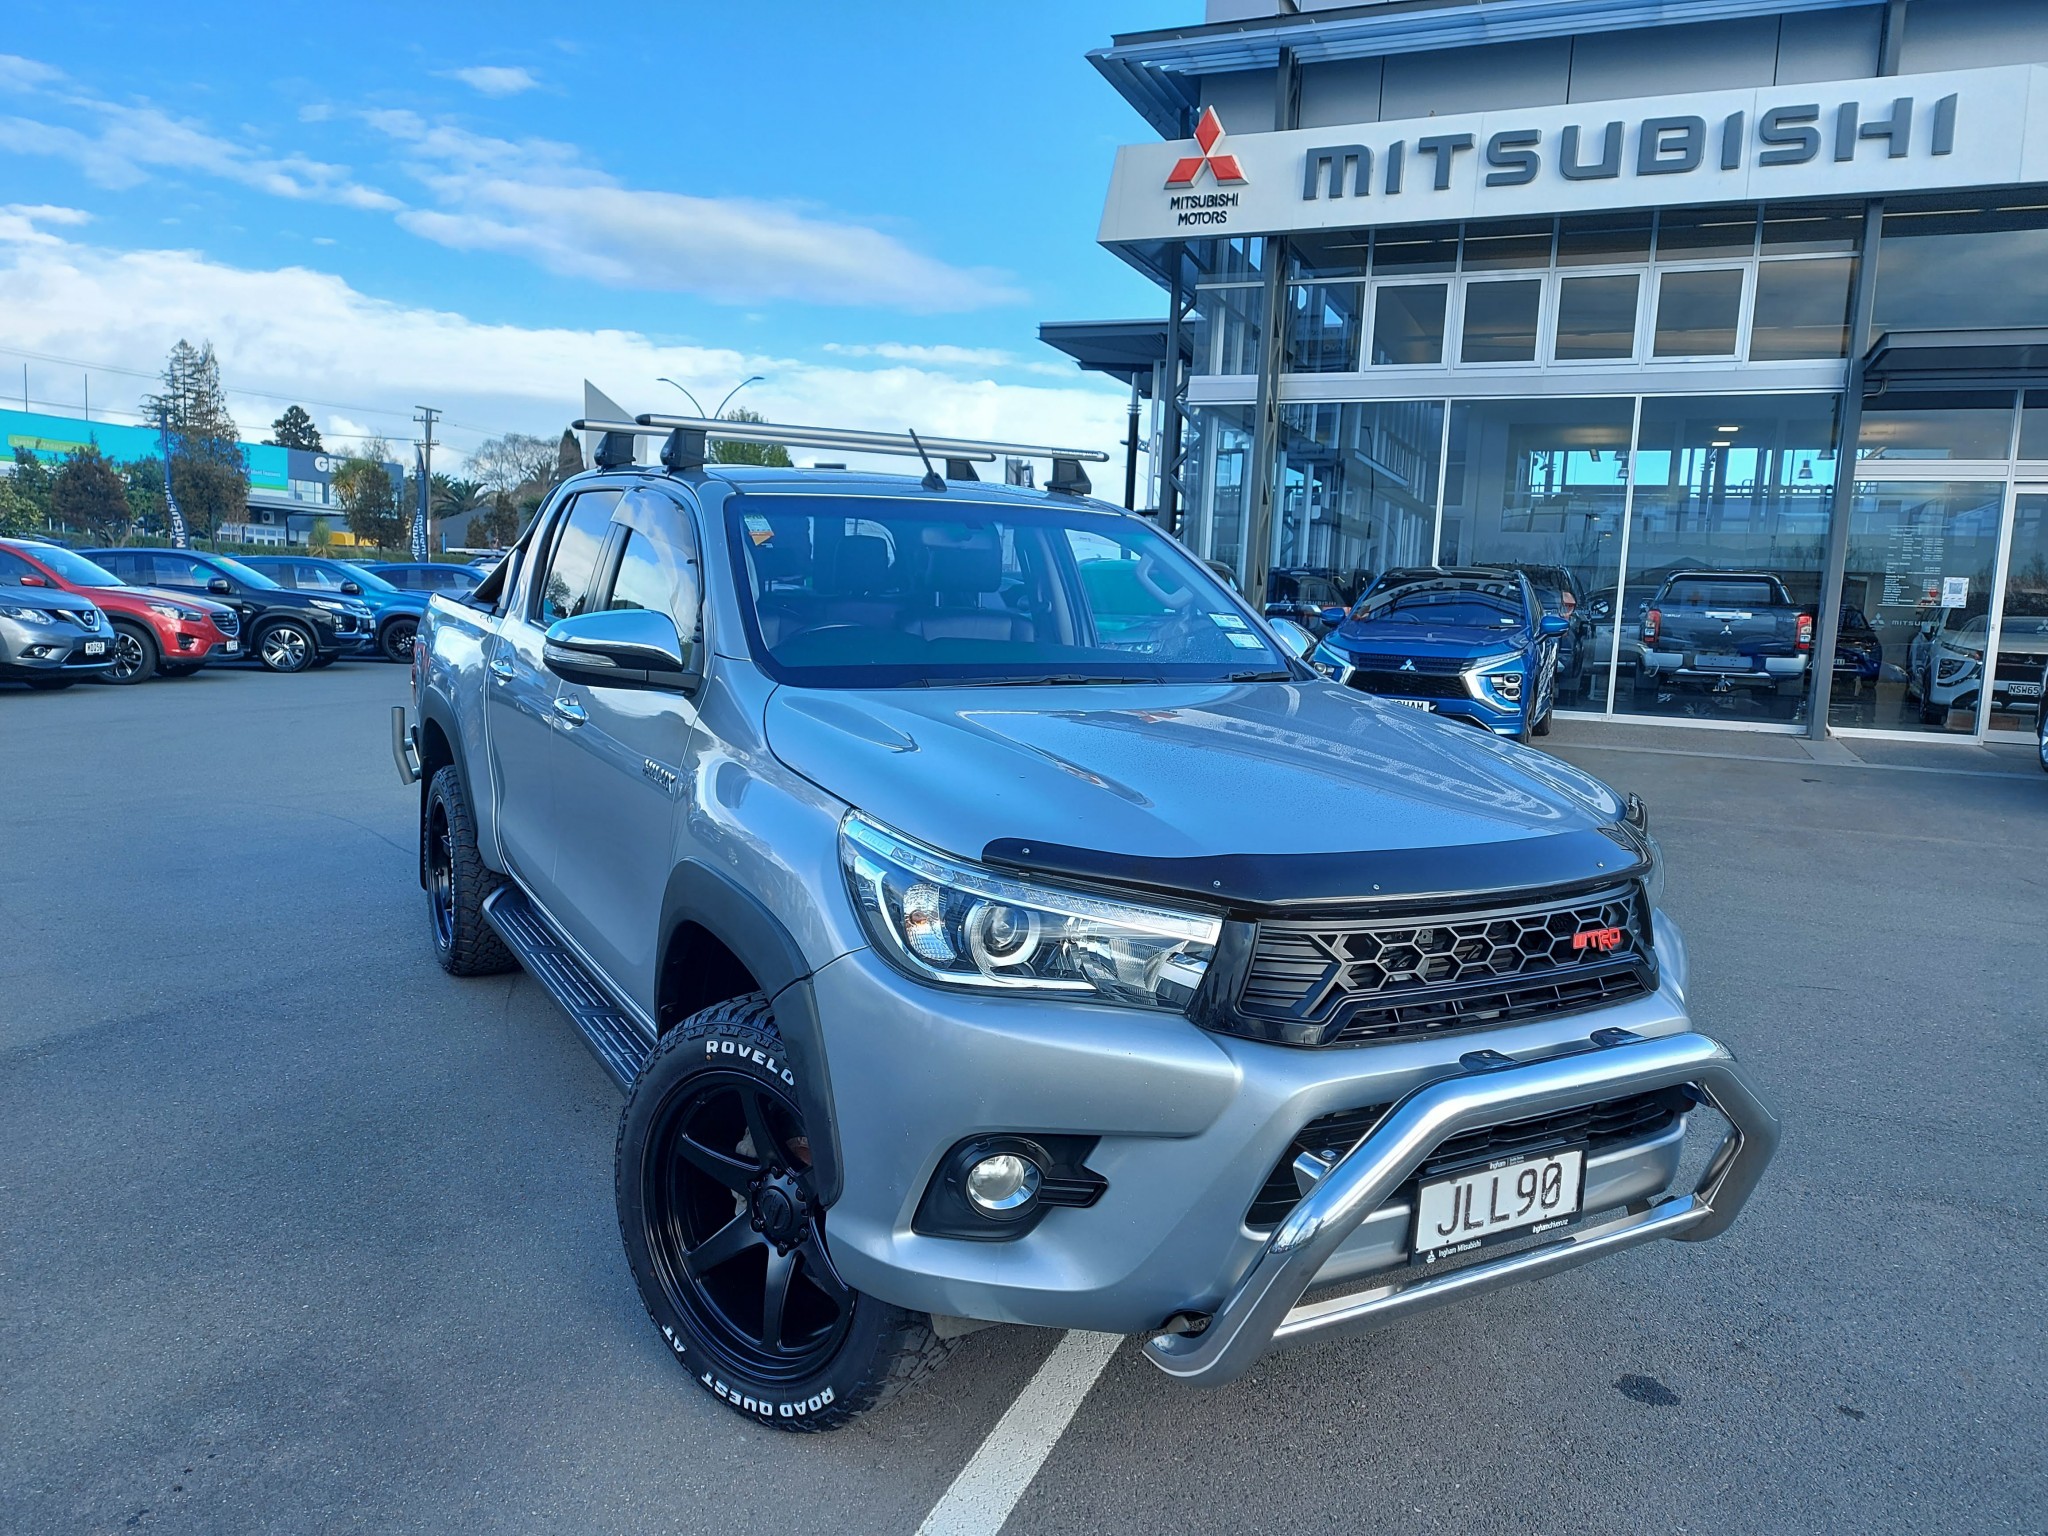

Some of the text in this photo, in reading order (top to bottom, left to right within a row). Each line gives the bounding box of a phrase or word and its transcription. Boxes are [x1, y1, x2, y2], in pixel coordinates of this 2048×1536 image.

[1303, 92, 1958, 200] MITSUBISHI
[1170, 192, 1239, 210] MITSUBISHI
[1177, 210, 1228, 226] MOTORS
[1587, 927, 1621, 952] TRD
[705, 1040, 795, 1086] ROVELO
[1437, 1162, 1563, 1236] JLL90
[1438, 1239, 1482, 1258] Ingham Mitsubishi
[661, 1324, 836, 1418] ROAD QUEST AT
